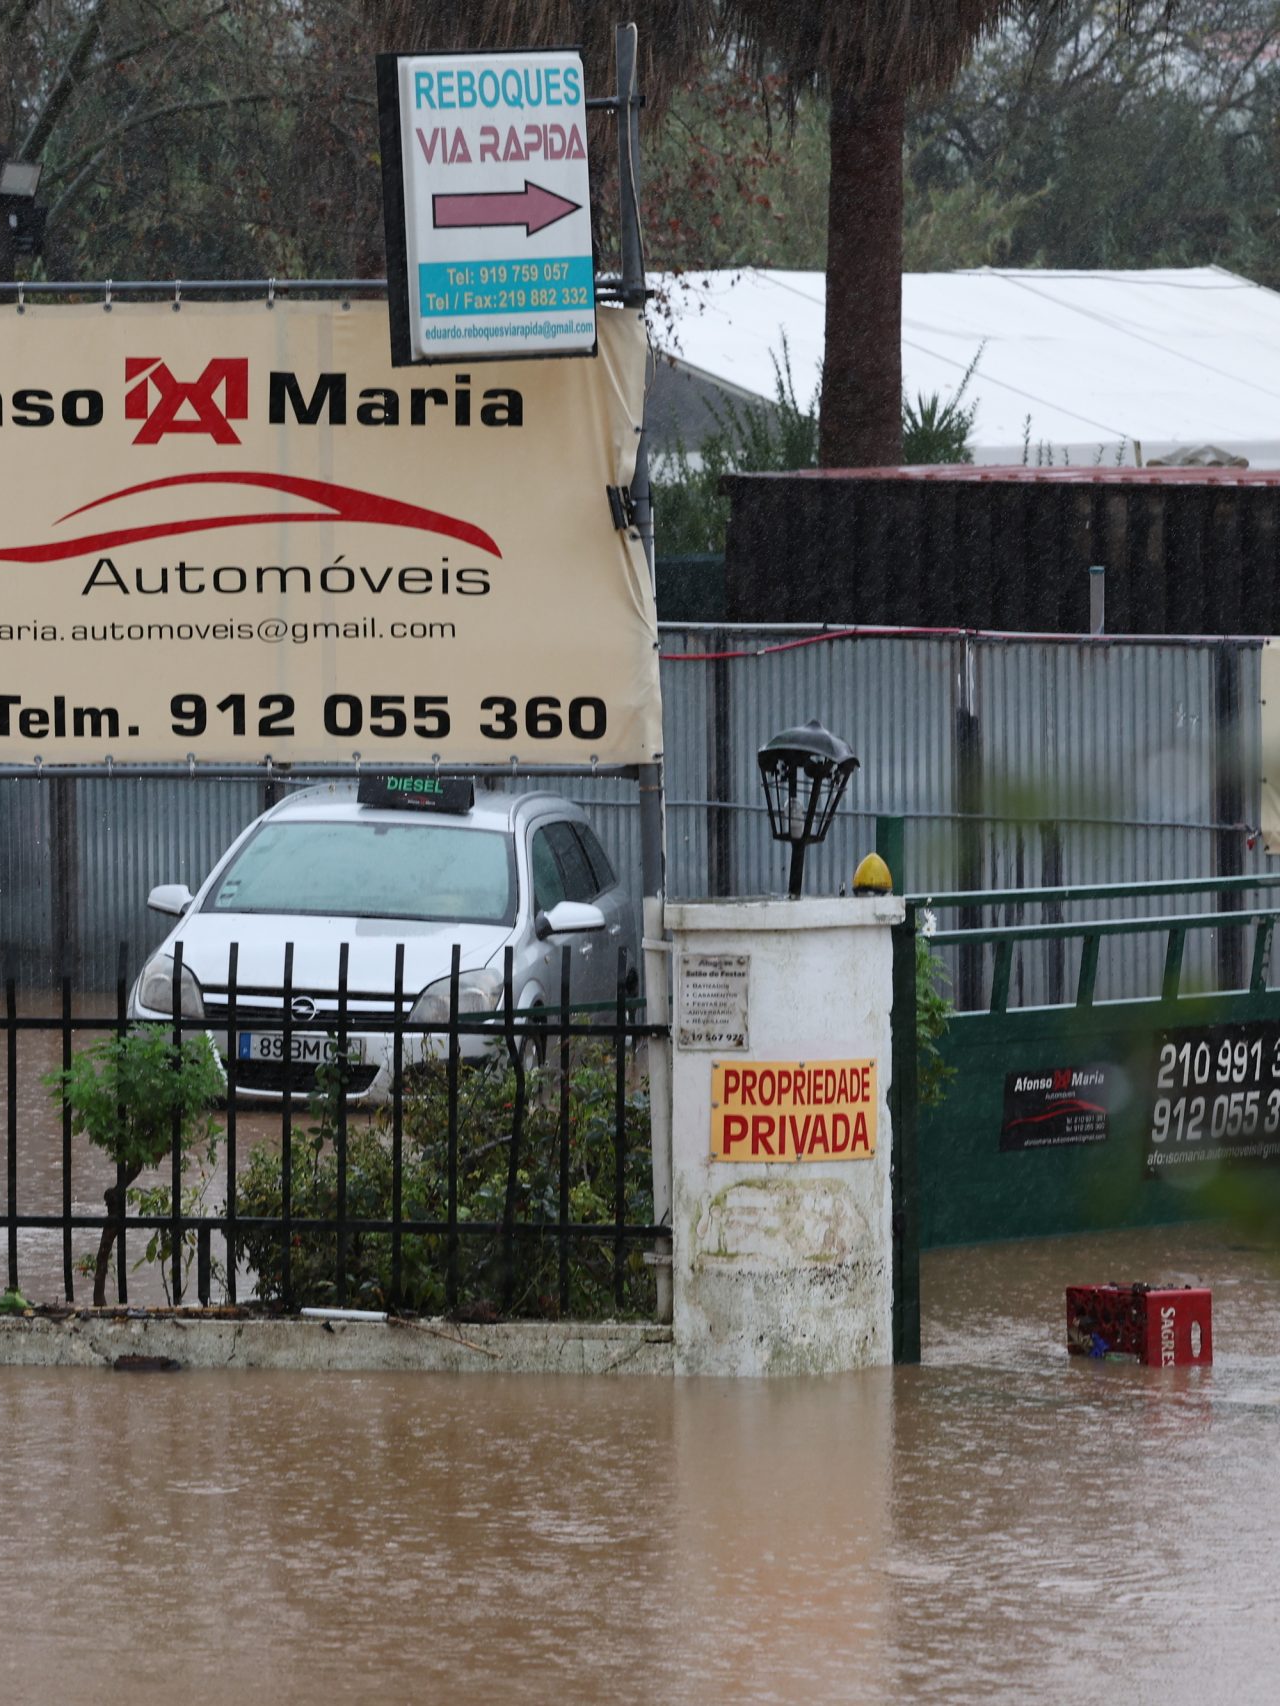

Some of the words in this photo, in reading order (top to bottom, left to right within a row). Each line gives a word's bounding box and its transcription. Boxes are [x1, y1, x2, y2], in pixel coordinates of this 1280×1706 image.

[414, 67, 582, 110] REBOQUES
[415, 126, 473, 165] VIA
[479, 122, 587, 162] RAPIDA
[447, 268, 475, 286] Tel:
[480, 266, 508, 284] 919
[512, 264, 539, 282] 759
[543, 262, 570, 281] 057
[426, 292, 450, 311] Tel
[530, 288, 557, 307] 882
[561, 287, 588, 305] 332
[424, 319, 593, 341] eduardo.reboquesviarapida@gmail.com
[268, 372, 524, 429] Maria
[81, 555, 491, 597] Automóveis
[170, 692, 295, 738] 912
[323, 694, 451, 739] 055
[479, 696, 607, 740] 360
[386, 776, 444, 795] DIESEL
[1014, 1075, 1053, 1093] Afonso
[1071, 1069, 1105, 1087] Maria
[1156, 1041, 1211, 1089] 210
[1215, 1038, 1262, 1083] 991
[723, 1067, 870, 1106] PROPRIEDADE
[722, 1111, 870, 1156] PRIVADA
[1151, 1095, 1206, 1143] 912
[1210, 1090, 1260, 1138] 055
